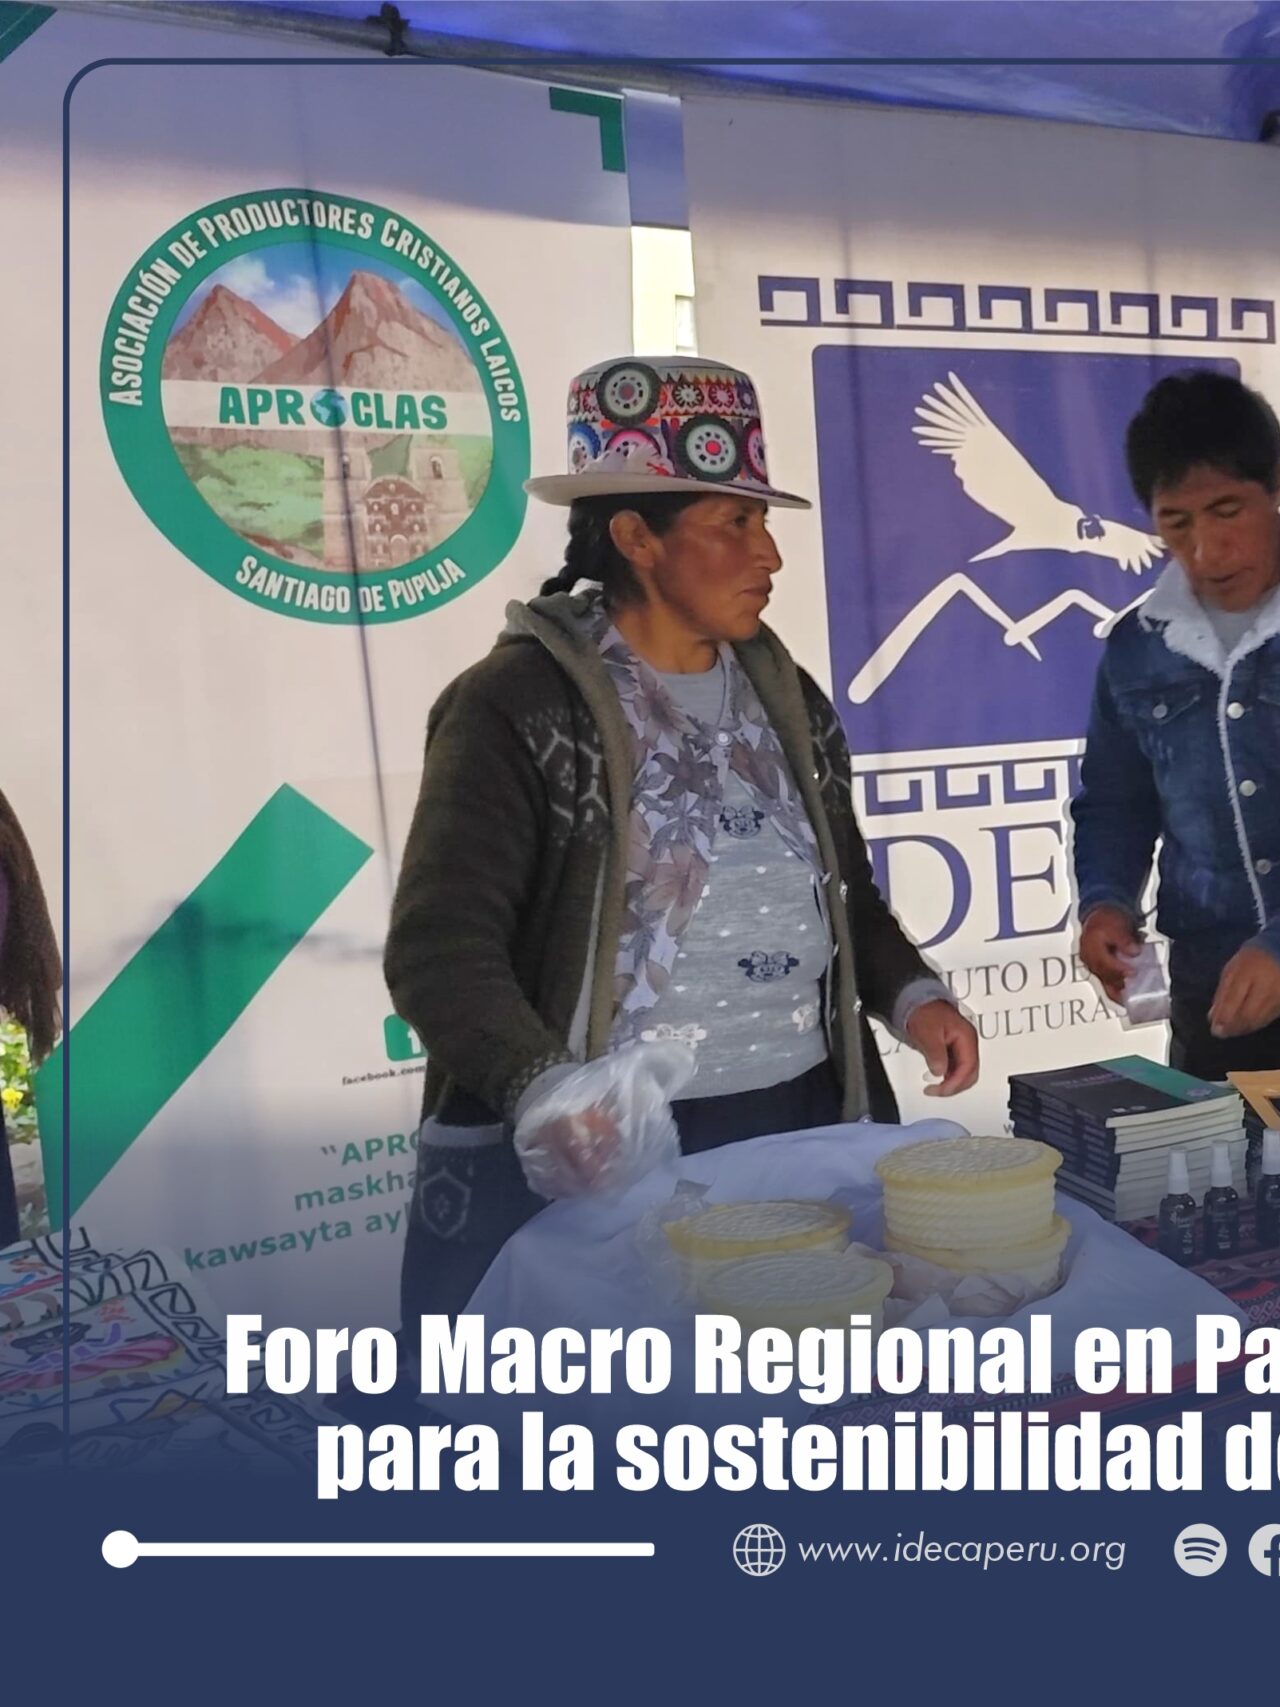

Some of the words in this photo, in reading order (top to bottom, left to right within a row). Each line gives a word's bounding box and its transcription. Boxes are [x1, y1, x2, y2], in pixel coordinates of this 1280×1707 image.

[109, 257, 182, 406] ASOCIACIÓN
[168, 231, 207, 269] DE
[197, 199, 374, 248] PRODUCTORES
[380, 218, 490, 336] CRISTIANOS
[480, 337, 521, 423] LAICOS
[235, 555, 350, 614] SANTIAGO
[357, 585, 387, 613] DE
[387, 557, 467, 609] PUPUJA
[865, 820, 1073, 951] DE
[946, 960, 1028, 1000] UTO
[976, 998, 1126, 1040] ULTURA
[183, 1220, 353, 1273] kawsayta
